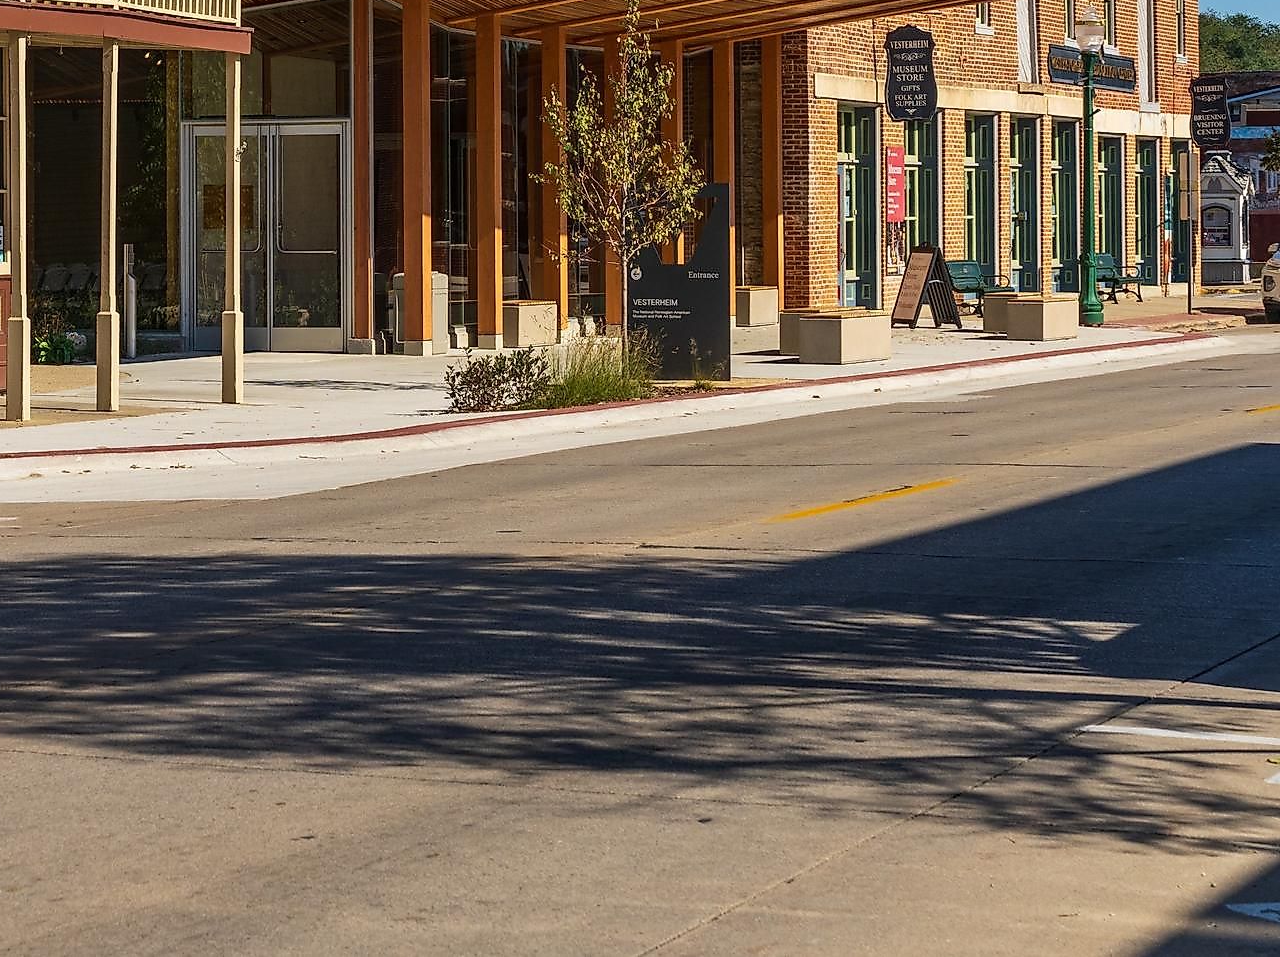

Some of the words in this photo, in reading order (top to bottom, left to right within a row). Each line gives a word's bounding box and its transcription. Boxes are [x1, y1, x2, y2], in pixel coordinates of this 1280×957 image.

[890, 40, 929, 49] VESTERHEIM
[892, 65, 928, 74] MUSEUM
[896, 73, 925, 82] STORE
[688, 271, 720, 279] Entrance
[632, 298, 678, 306] VESTERHEIM
